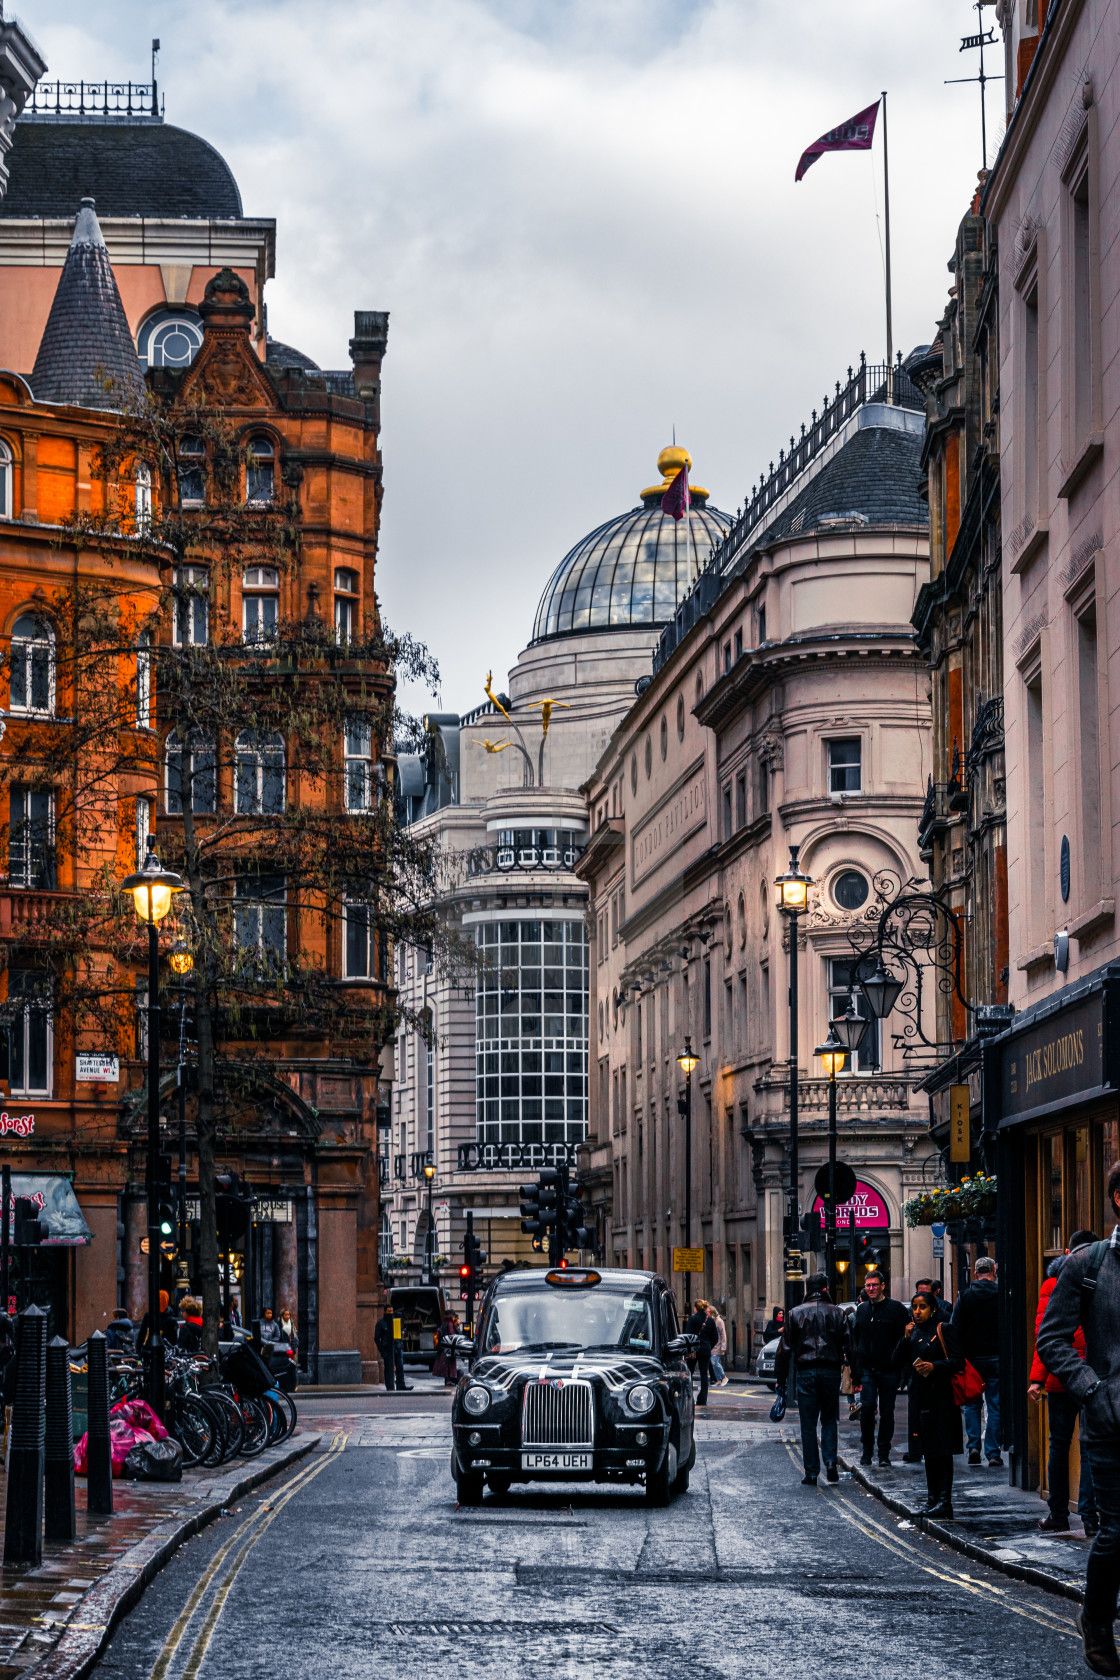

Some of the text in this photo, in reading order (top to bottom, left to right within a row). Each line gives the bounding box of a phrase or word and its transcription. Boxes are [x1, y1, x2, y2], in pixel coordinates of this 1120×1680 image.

[1025, 1048, 1042, 1093] JACK
[1043, 1029, 1084, 1079] SOLOMONS
[0, 1113, 34, 1136] forest
[819, 1206, 879, 1218] WRLDS
[526, 1455, 588, 1468] LP64 UEH
